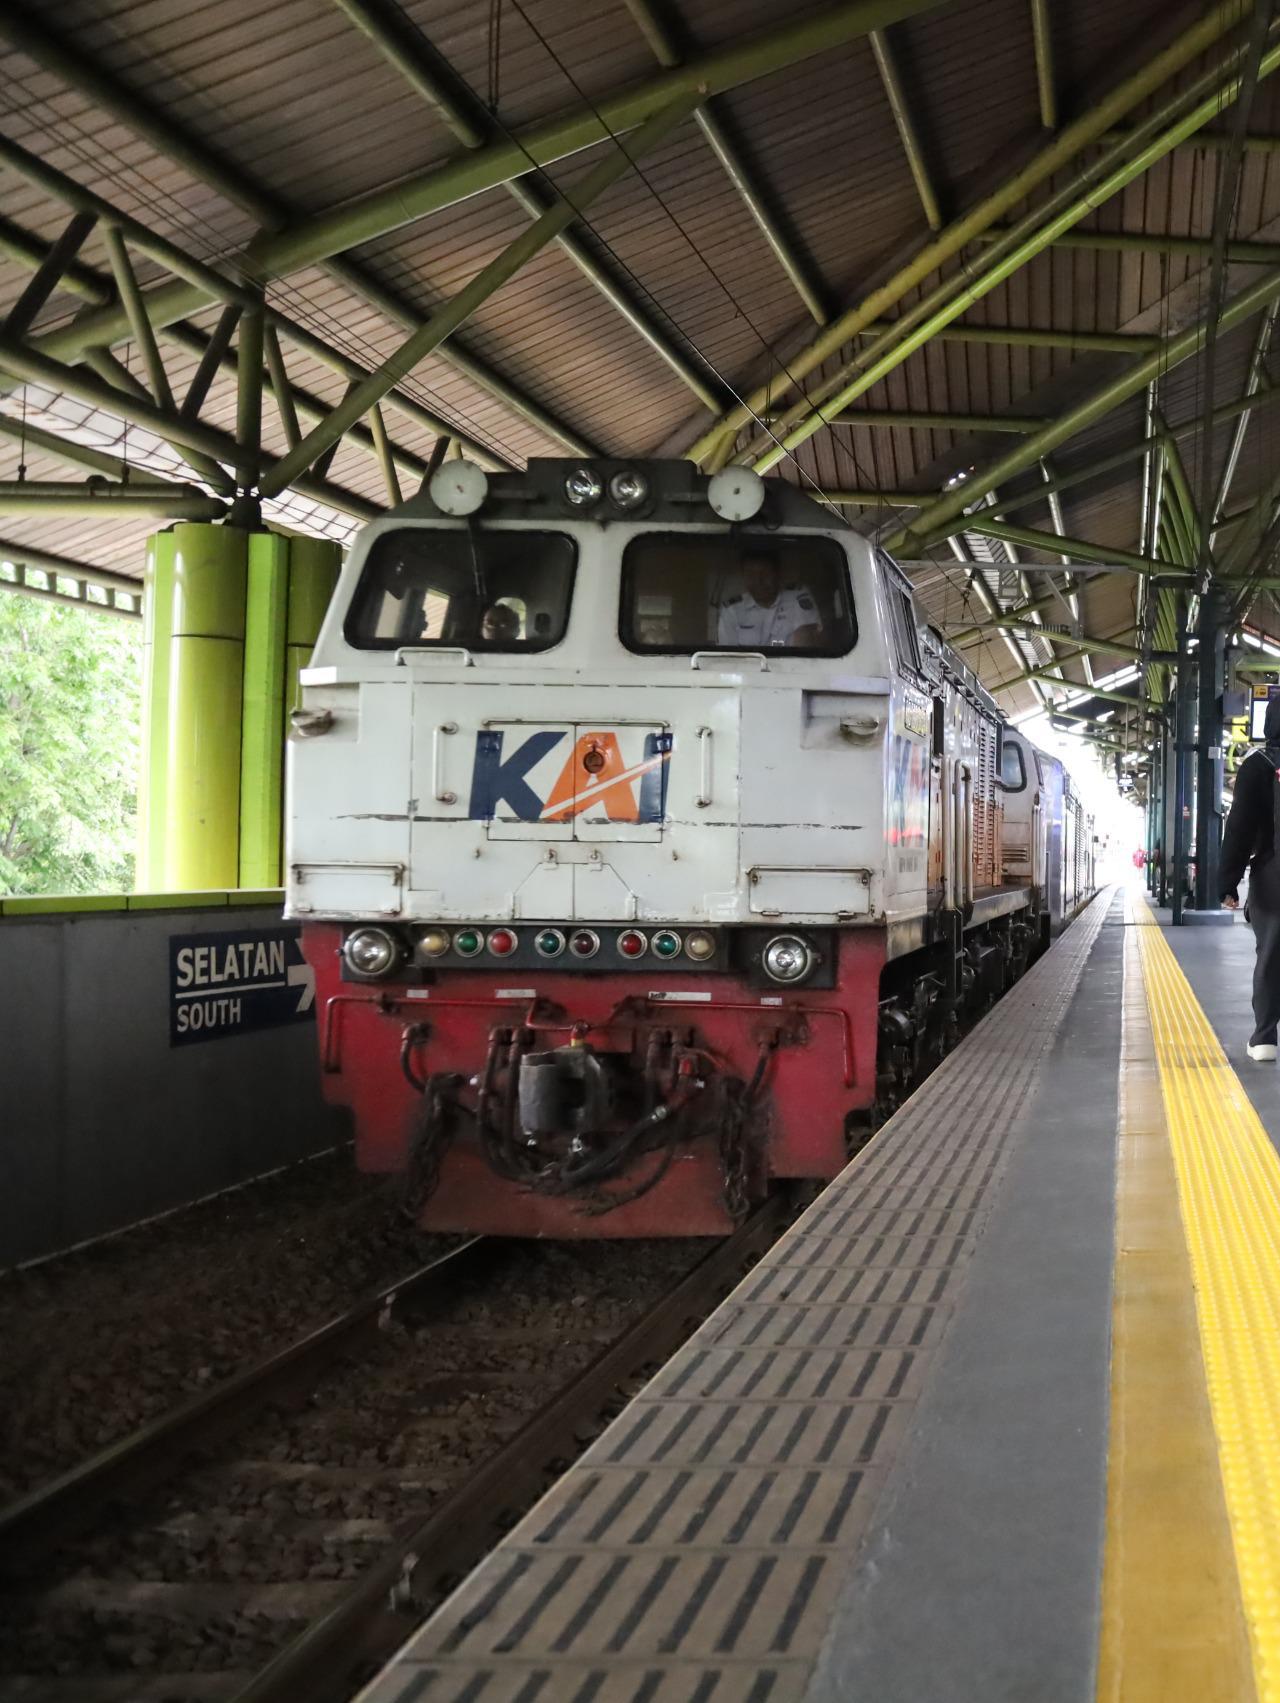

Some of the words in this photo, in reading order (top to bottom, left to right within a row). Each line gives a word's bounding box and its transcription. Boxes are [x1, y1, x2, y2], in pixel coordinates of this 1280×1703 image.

[469, 730, 674, 824] KAI
[176, 940, 285, 987] SELATAN
[177, 998, 241, 1032] SOUTH
